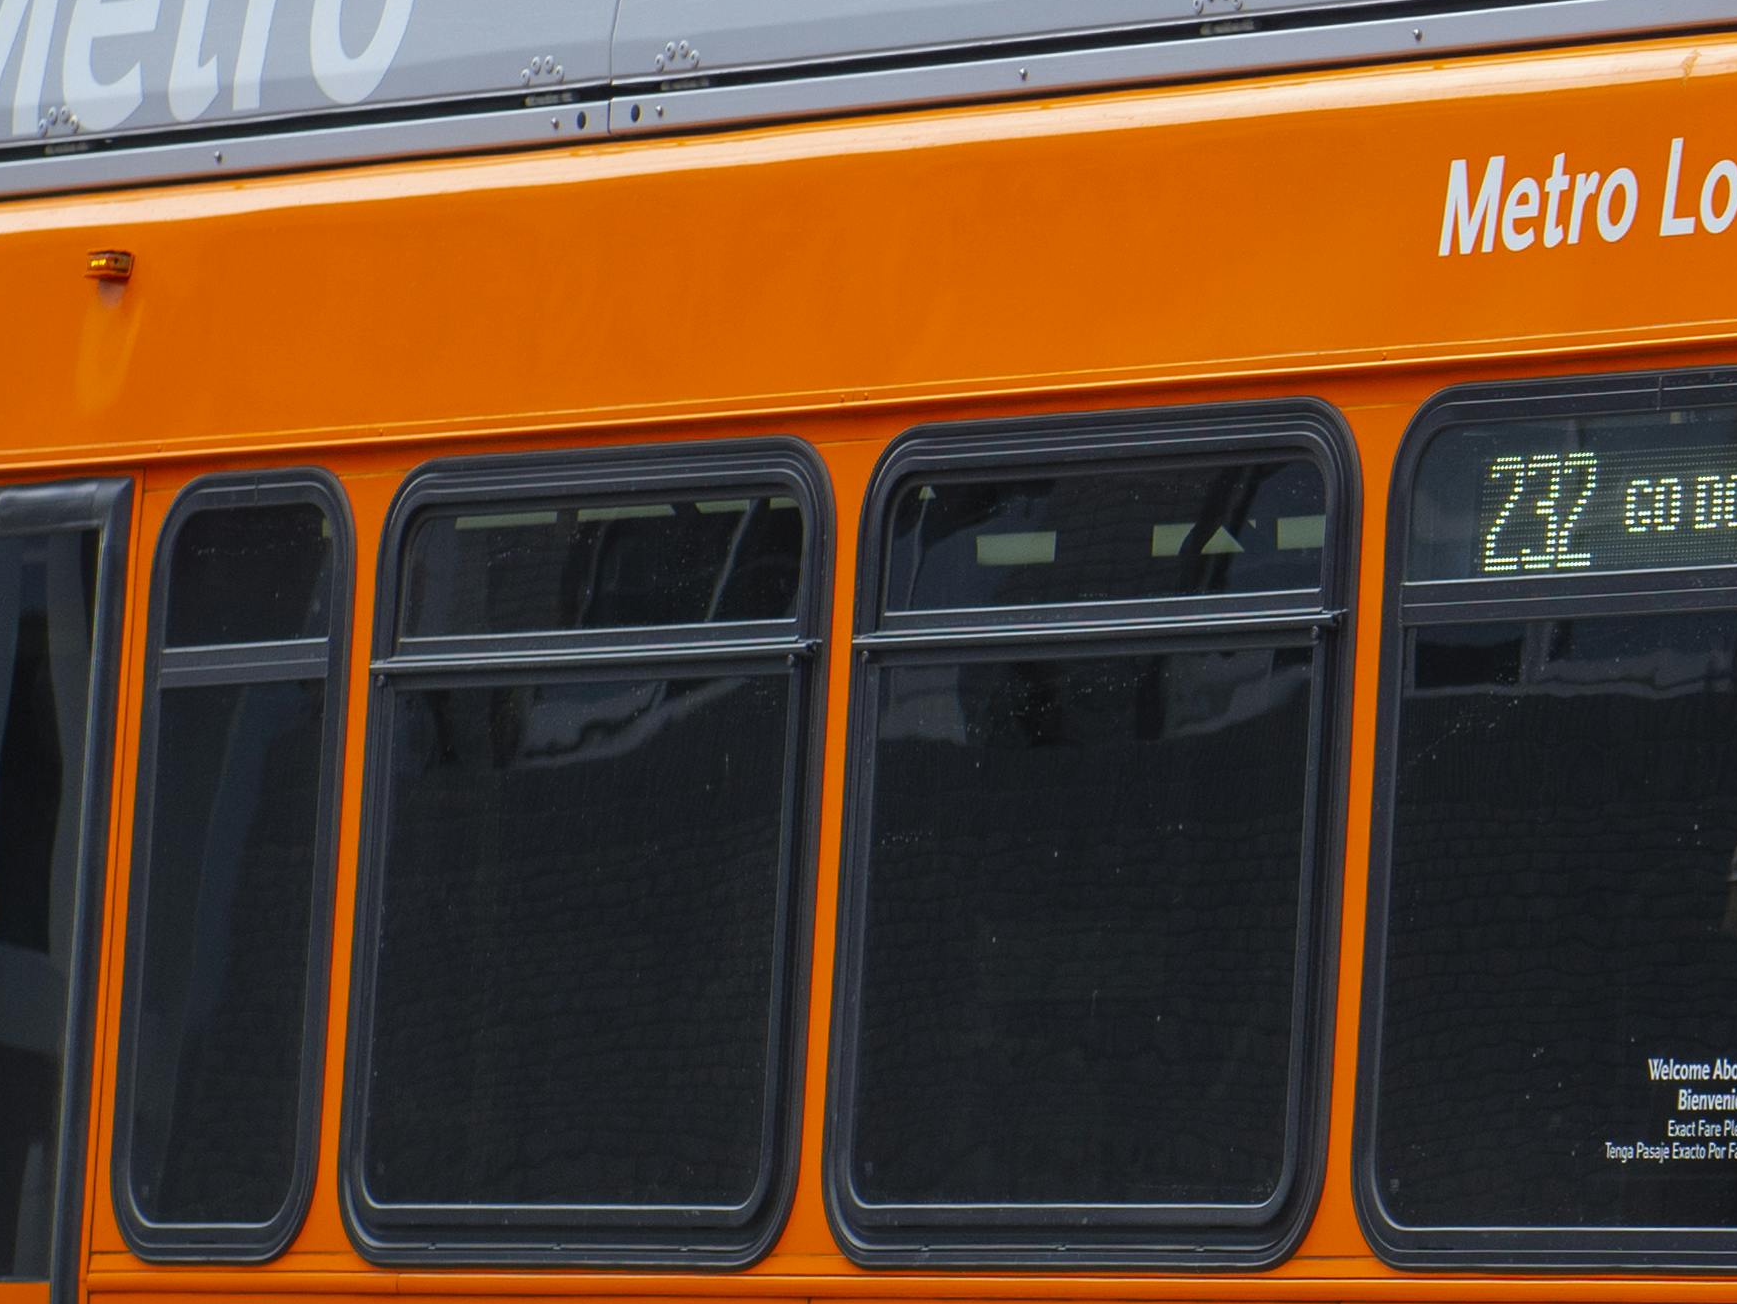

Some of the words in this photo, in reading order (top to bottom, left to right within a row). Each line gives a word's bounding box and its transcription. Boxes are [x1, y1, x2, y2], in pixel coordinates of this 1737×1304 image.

[1438, 152, 1639, 257] Metro
[1483, 451, 1598, 572] 232
[1625, 477, 1682, 533] GO
[1648, 1058, 1711, 1081] Welcome
[1667, 1119, 1696, 1137] Exact
[1698, 1119, 1722, 1137] Fare
[1605, 1142, 1634, 1163] Tenga
[1636, 1142, 1670, 1164] Pasaje
[1672, 1142, 1706, 1160] Exacto
[1708, 1142, 1726, 1160] Por
